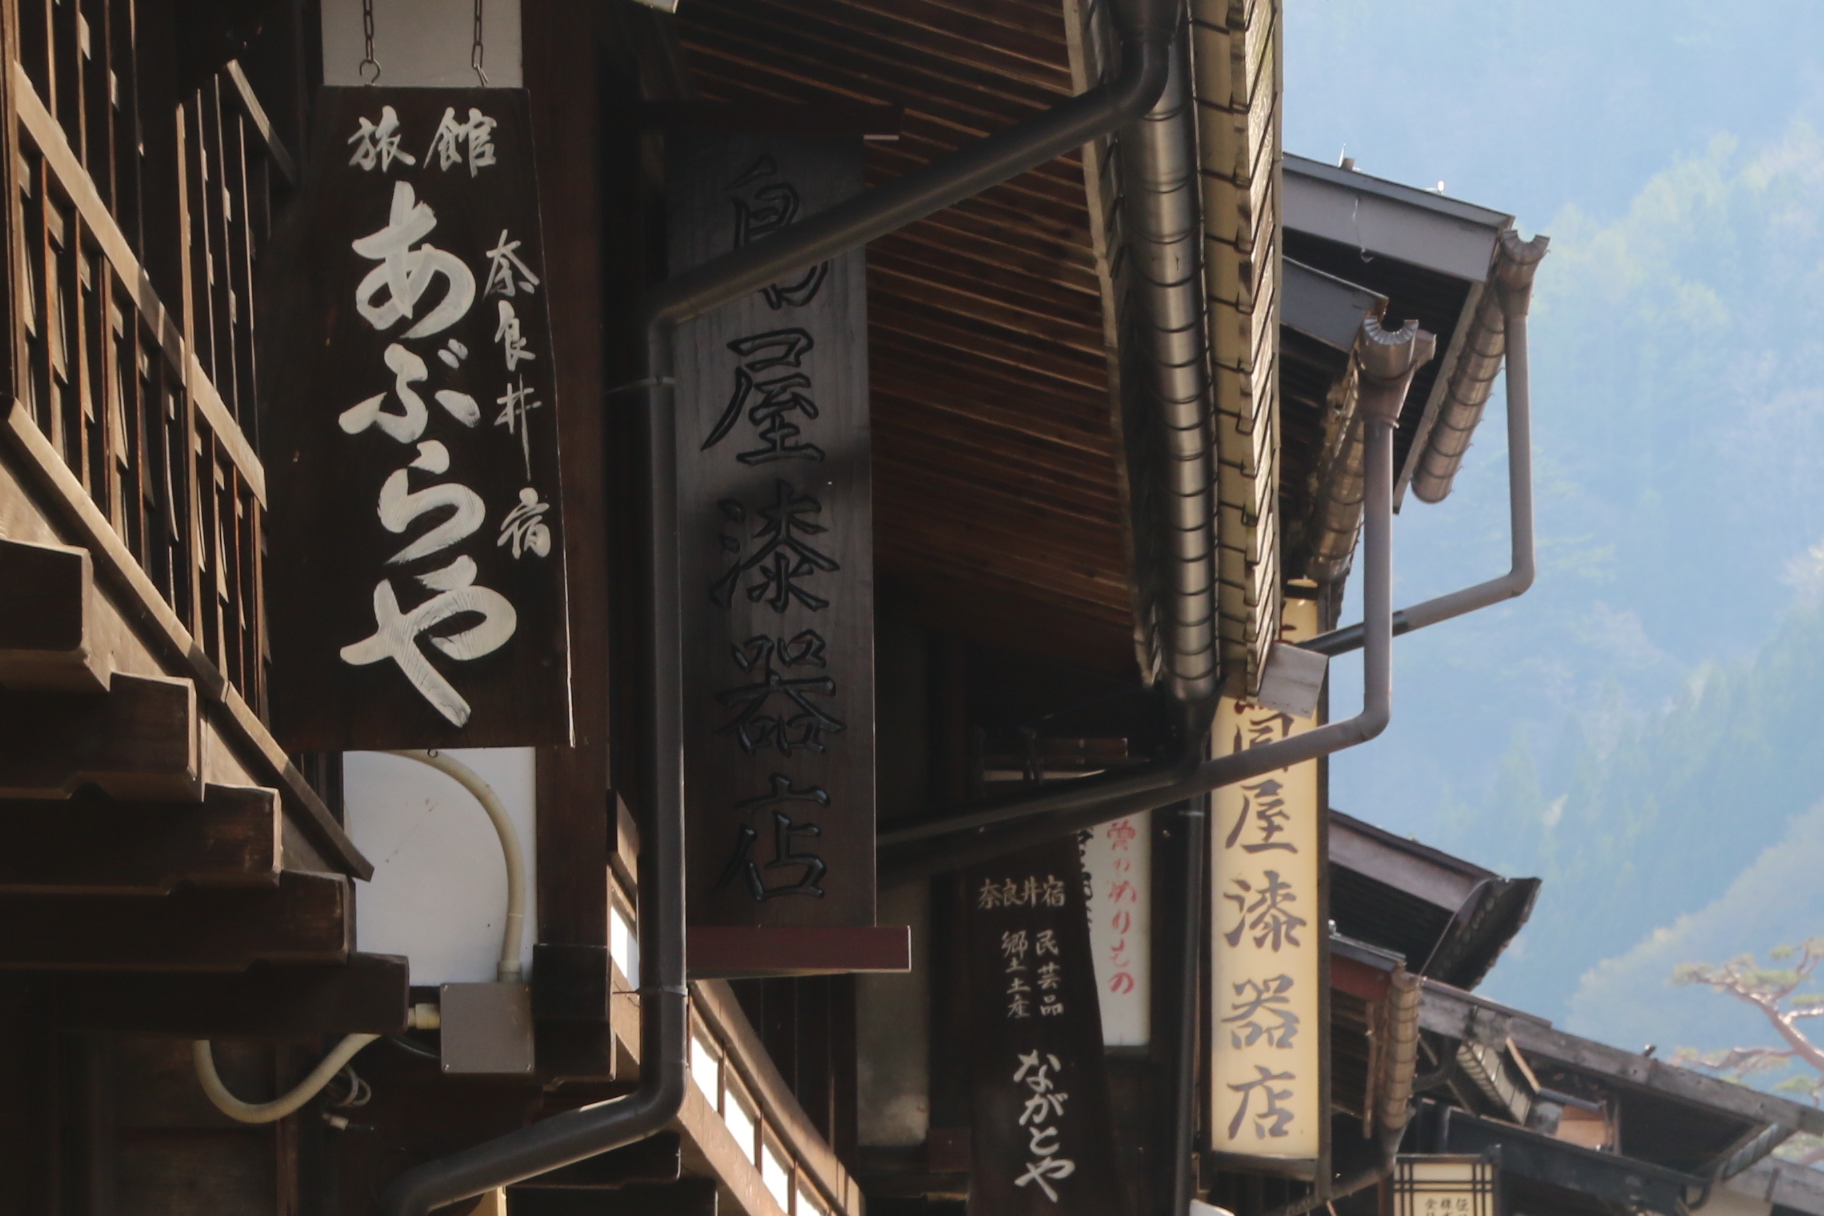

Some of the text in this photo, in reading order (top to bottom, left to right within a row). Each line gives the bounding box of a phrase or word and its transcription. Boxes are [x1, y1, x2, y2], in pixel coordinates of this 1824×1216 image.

[348, 105, 498, 177] 旅館
[338, 181, 517, 728] あぶらや
[484, 229, 552, 560] 奈良井宿
[978, 876, 1065, 909] 奈良井宿
[1221, 593, 1305, 1140] 屋漆器店
[1035, 928, 1064, 1016] 民芸品
[1013, 1049, 1076, 1203] ながとや
